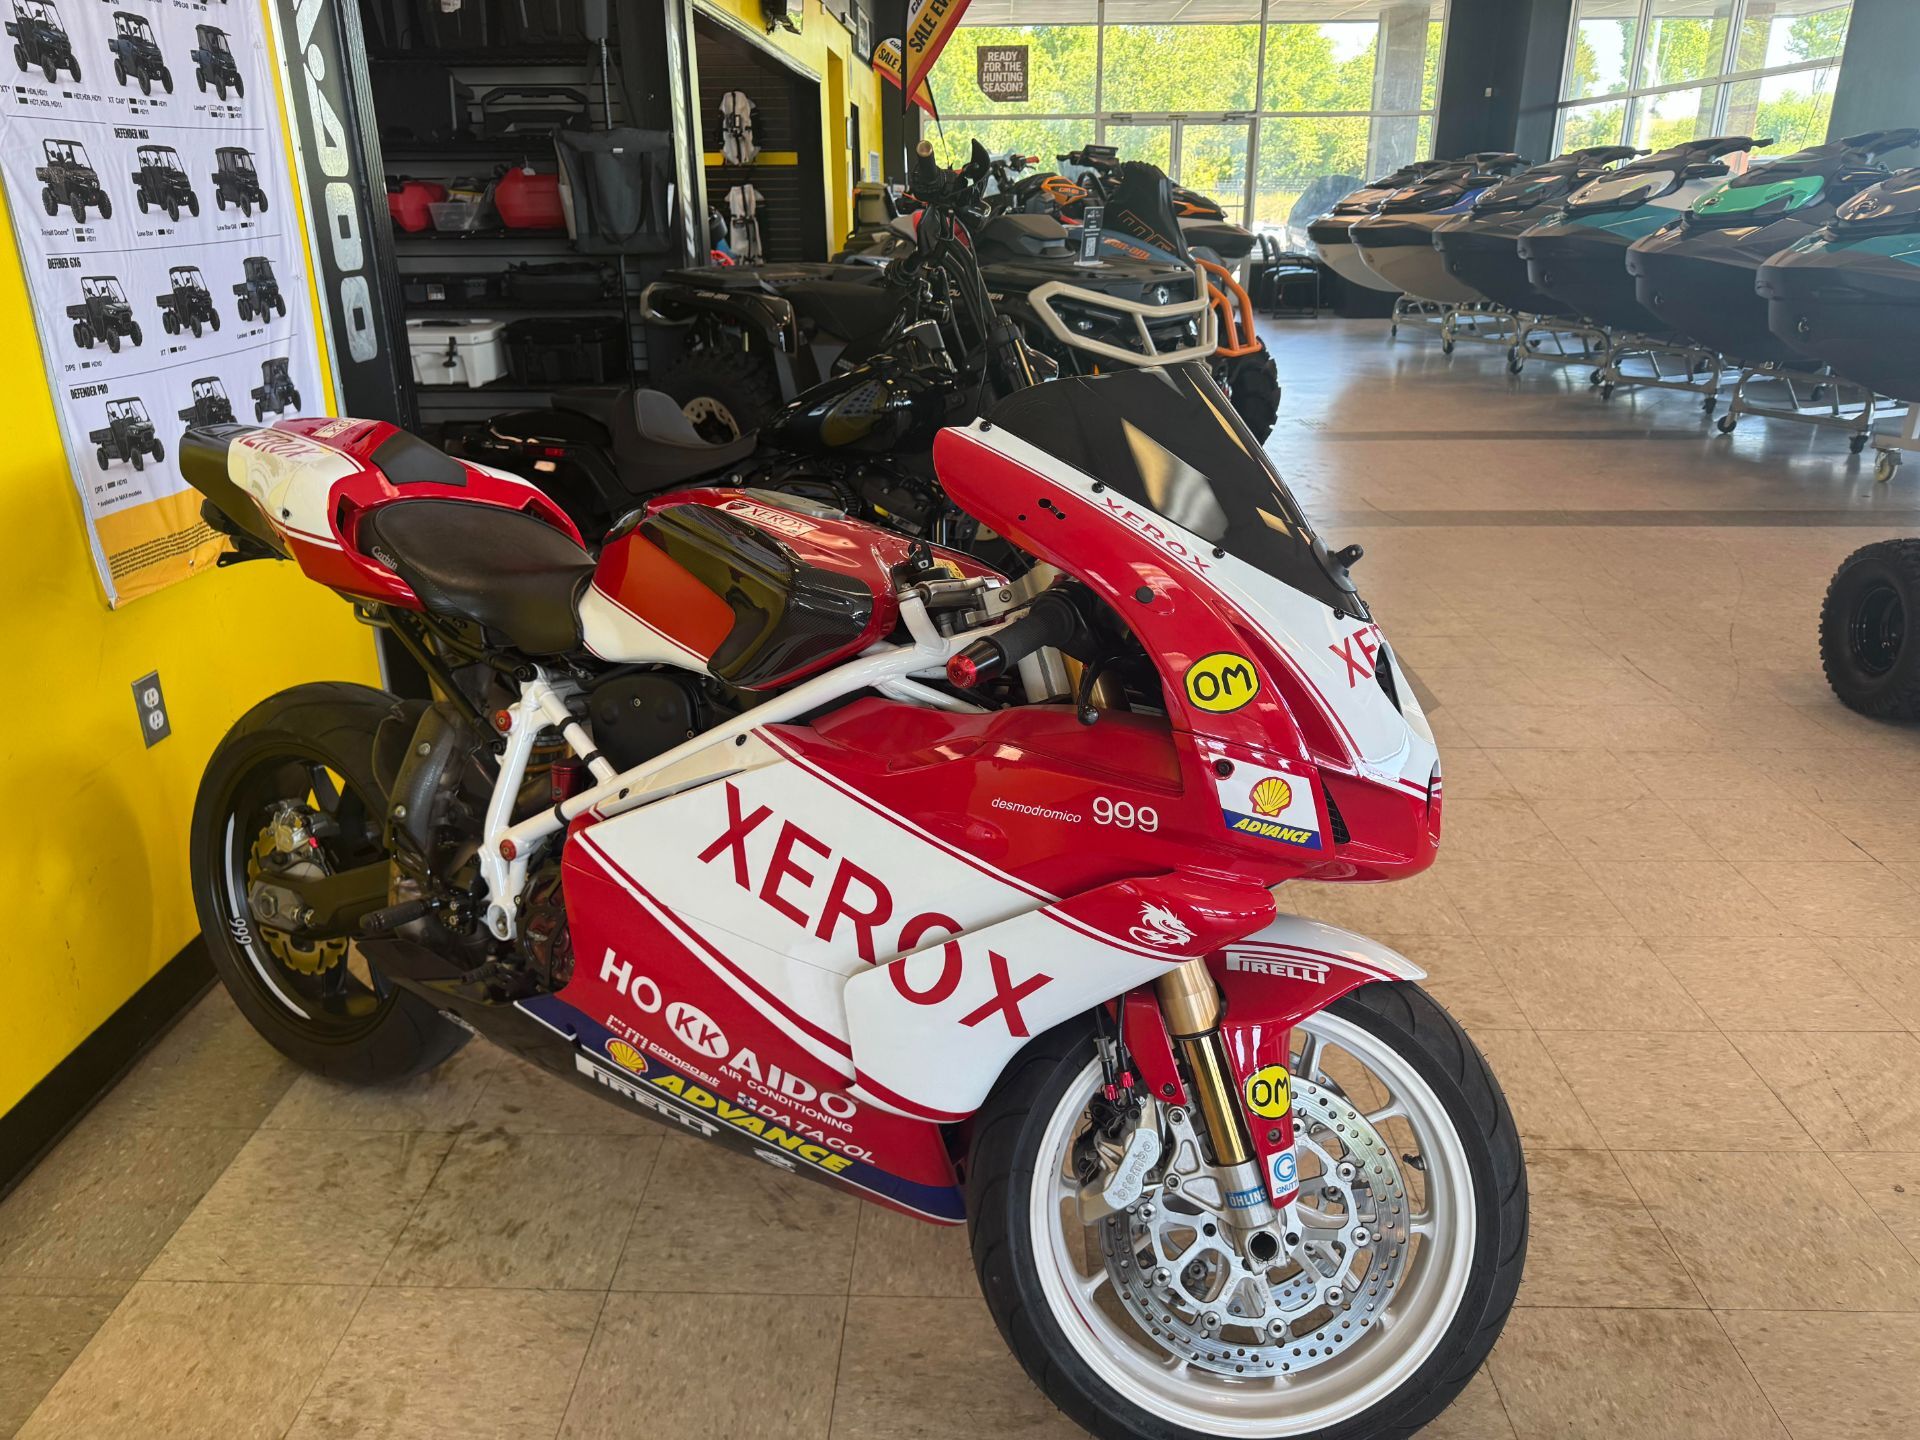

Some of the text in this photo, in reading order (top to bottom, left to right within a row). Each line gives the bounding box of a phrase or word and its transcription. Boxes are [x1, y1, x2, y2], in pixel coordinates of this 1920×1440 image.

[909, 13, 938, 53] SALE
[878, 48, 899, 69] SALE
[984, 62, 1022, 72] FOR THE
[987, 51, 1018, 62] READY
[982, 72, 1023, 82] HUNTING
[982, 82, 1024, 93] SEASON?
[113, 127, 150, 140] DEFENDER MAX
[47, 256, 82, 270] DEFENDER 6X6
[70, 383, 109, 400] DEFENDER PRO
[750, 506, 806, 531] XEROX
[1101, 497, 1212, 575] XEROX
[371, 545, 398, 571] Corbin
[1192, 663, 1253, 702] OM
[991, 796, 1159, 833] desmodromico 999
[1233, 817, 1313, 844] ADVANCE
[697, 781, 1055, 1038] XEROX
[228, 918, 252, 945] 999
[1226, 951, 1330, 985] PIRELLI
[599, 946, 857, 1119] HOKKAIDO
[575, 1052, 720, 1137] PIRELLI
[718, 1065, 854, 1134] AIR CONDITIONING
[1251, 1076, 1290, 1108] OM
[650, 1074, 854, 1173] ADVANCE
[757, 1104, 876, 1165] DATACOL
[1112, 1140, 1154, 1201] brembo
